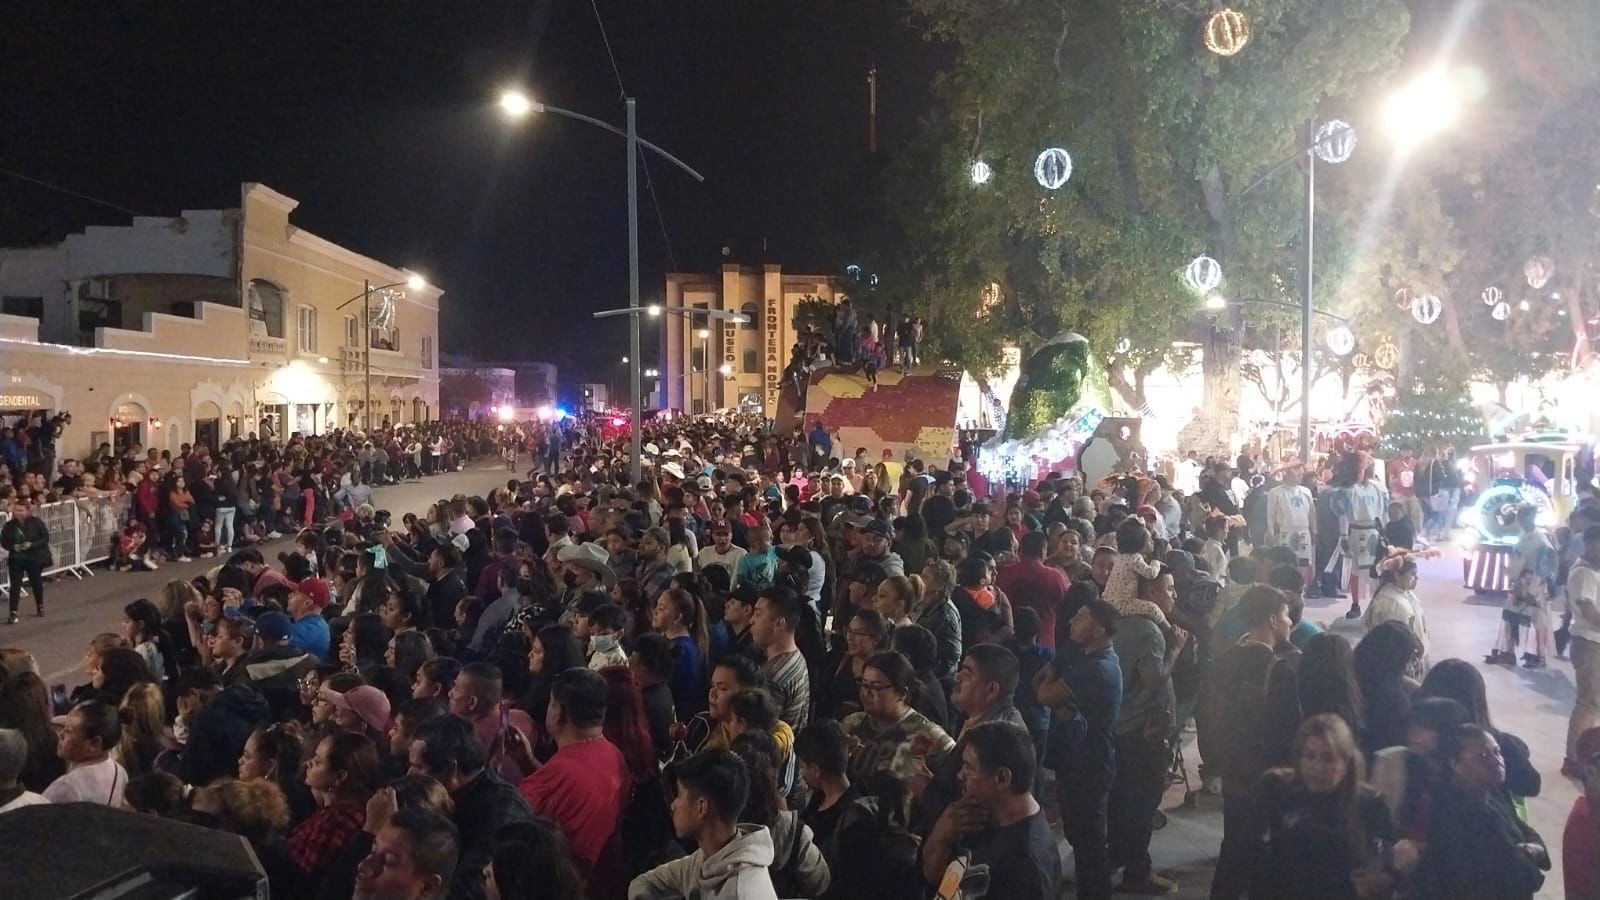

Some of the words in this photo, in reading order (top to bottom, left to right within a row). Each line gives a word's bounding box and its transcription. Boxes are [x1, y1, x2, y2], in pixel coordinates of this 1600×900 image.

[725, 322, 736, 362] MUSEO
[767, 299, 777, 362] FRONTERA
[767, 366, 777, 404] NORTE
